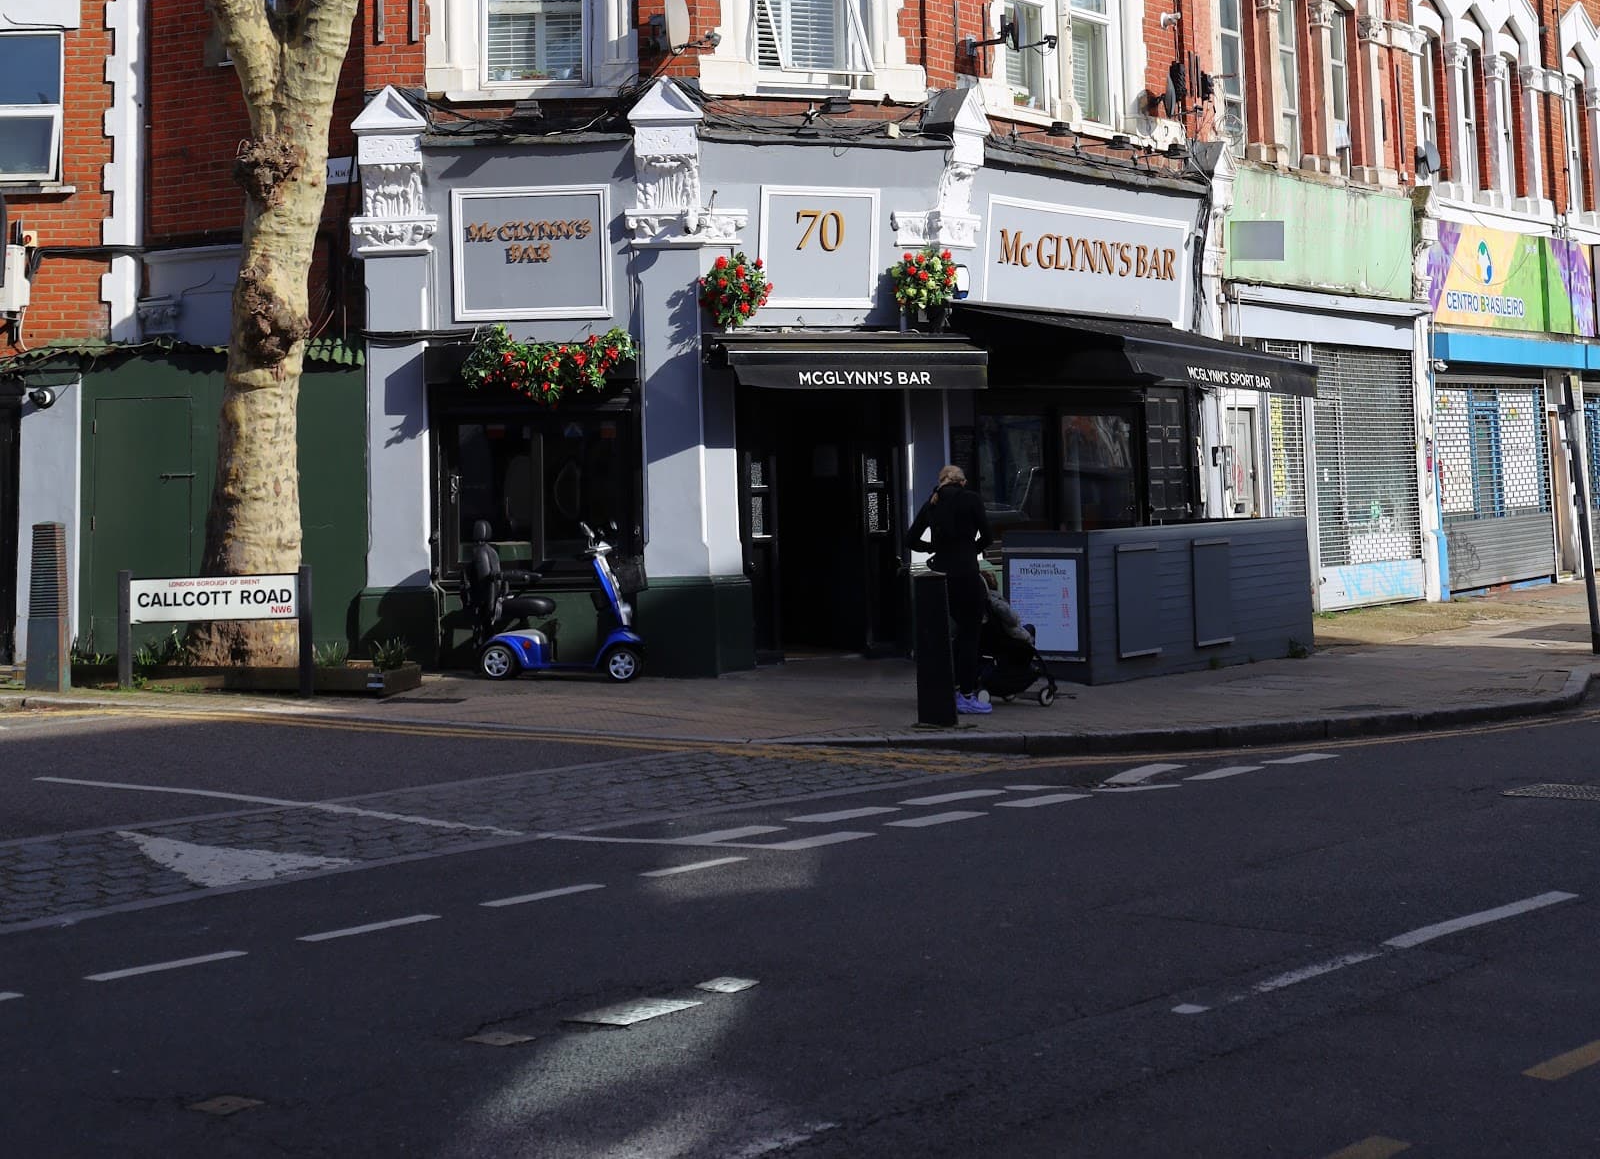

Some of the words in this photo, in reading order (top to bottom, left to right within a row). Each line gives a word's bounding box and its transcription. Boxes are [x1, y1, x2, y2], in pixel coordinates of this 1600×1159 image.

[796, 210, 845, 252] 70
[505, 243, 551, 263] BAR
[1135, 244, 1176, 281] BAR
[1446, 292, 1478, 312] CENTRO
[1480, 296, 1524, 316] BRASILEIRO
[798, 371, 893, 385] MCGLYNN'S
[897, 371, 931, 385] BAR
[1186, 366, 1229, 384] MCGLYNN'S
[1230, 372, 1255, 387] SPORT
[1255, 376, 1272, 389] BAR
[168, 580, 195, 588] LONDON
[196, 579, 228, 587] BOROUGH
[137, 591, 232, 608] CALLCOTT
[240, 589, 292, 604] ROAD
[270, 605, 293, 614] NW6
